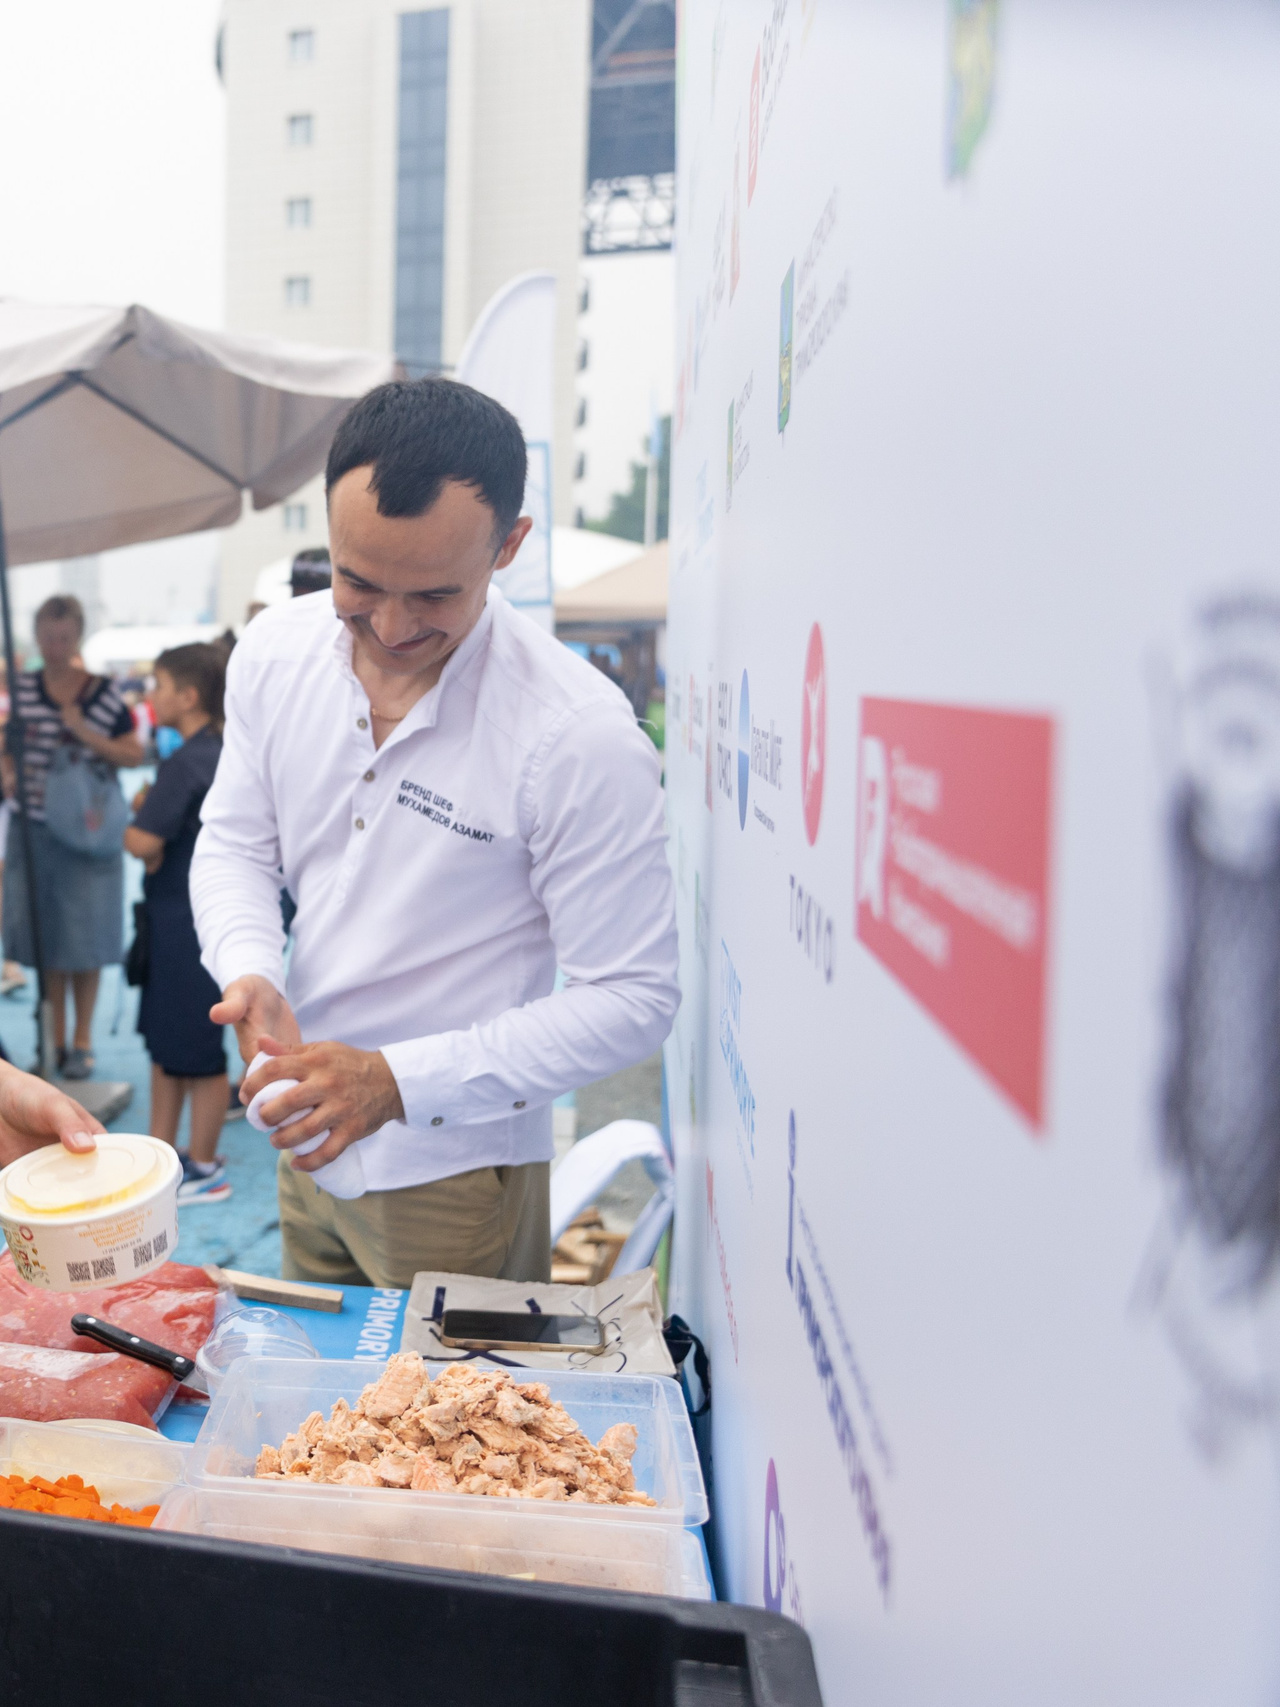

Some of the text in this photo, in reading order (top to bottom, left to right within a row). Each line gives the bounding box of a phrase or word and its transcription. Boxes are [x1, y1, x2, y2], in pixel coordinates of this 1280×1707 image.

[396, 793, 495, 844] МУХАМЕДОВ АЗАМАТ
[400, 779, 454, 813] БРЕНД ШЕФ
[789, 874, 834, 985] TOKYO
